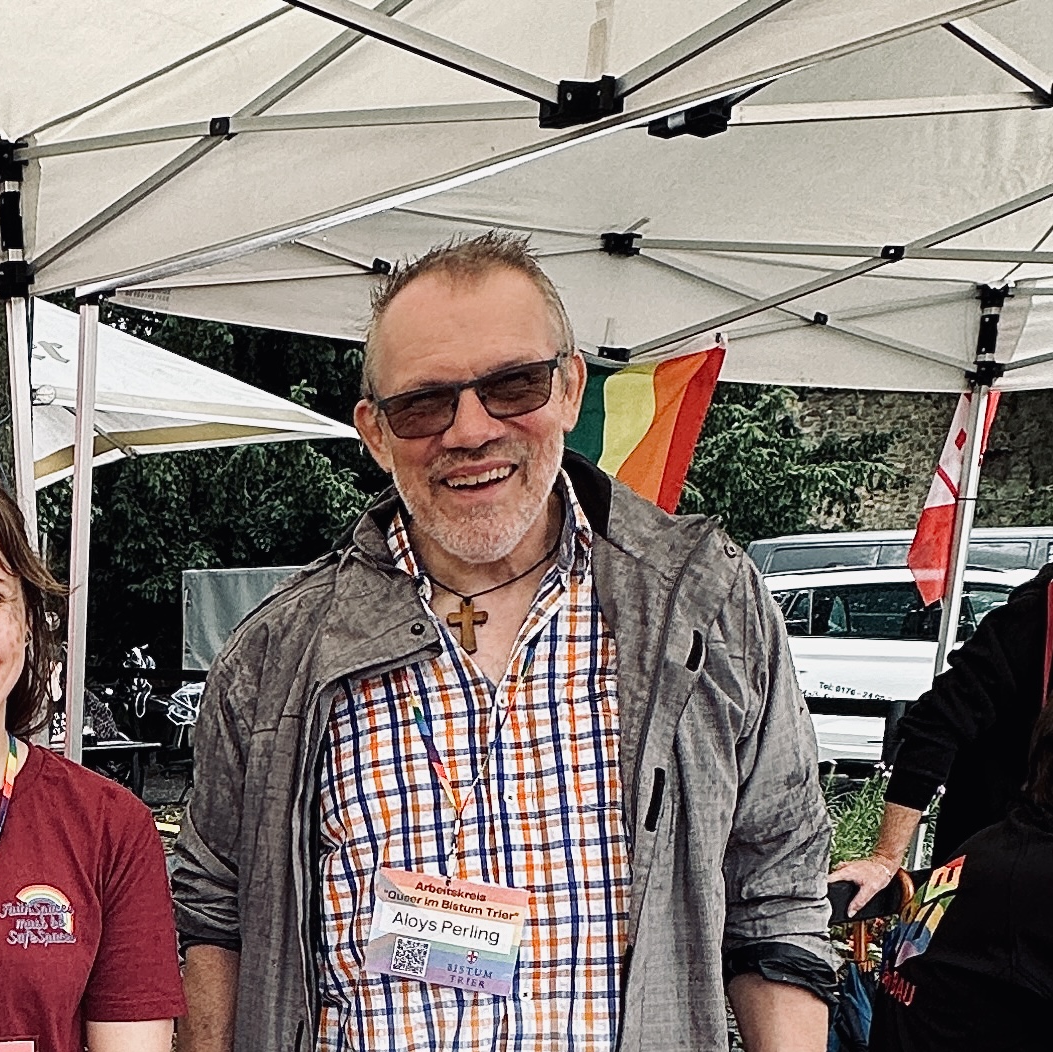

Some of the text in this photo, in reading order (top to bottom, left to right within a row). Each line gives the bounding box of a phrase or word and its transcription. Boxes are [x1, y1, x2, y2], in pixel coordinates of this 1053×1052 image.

[415, 881, 487, 902] Arbeitskreis
[424, 897, 439, 908] im
[441, 900, 483, 916] Bistum
[392, 911, 500, 946] Aloys Perling
[447, 963, 493, 979] BISTUM
[449, 974, 485, 989] TRIER
